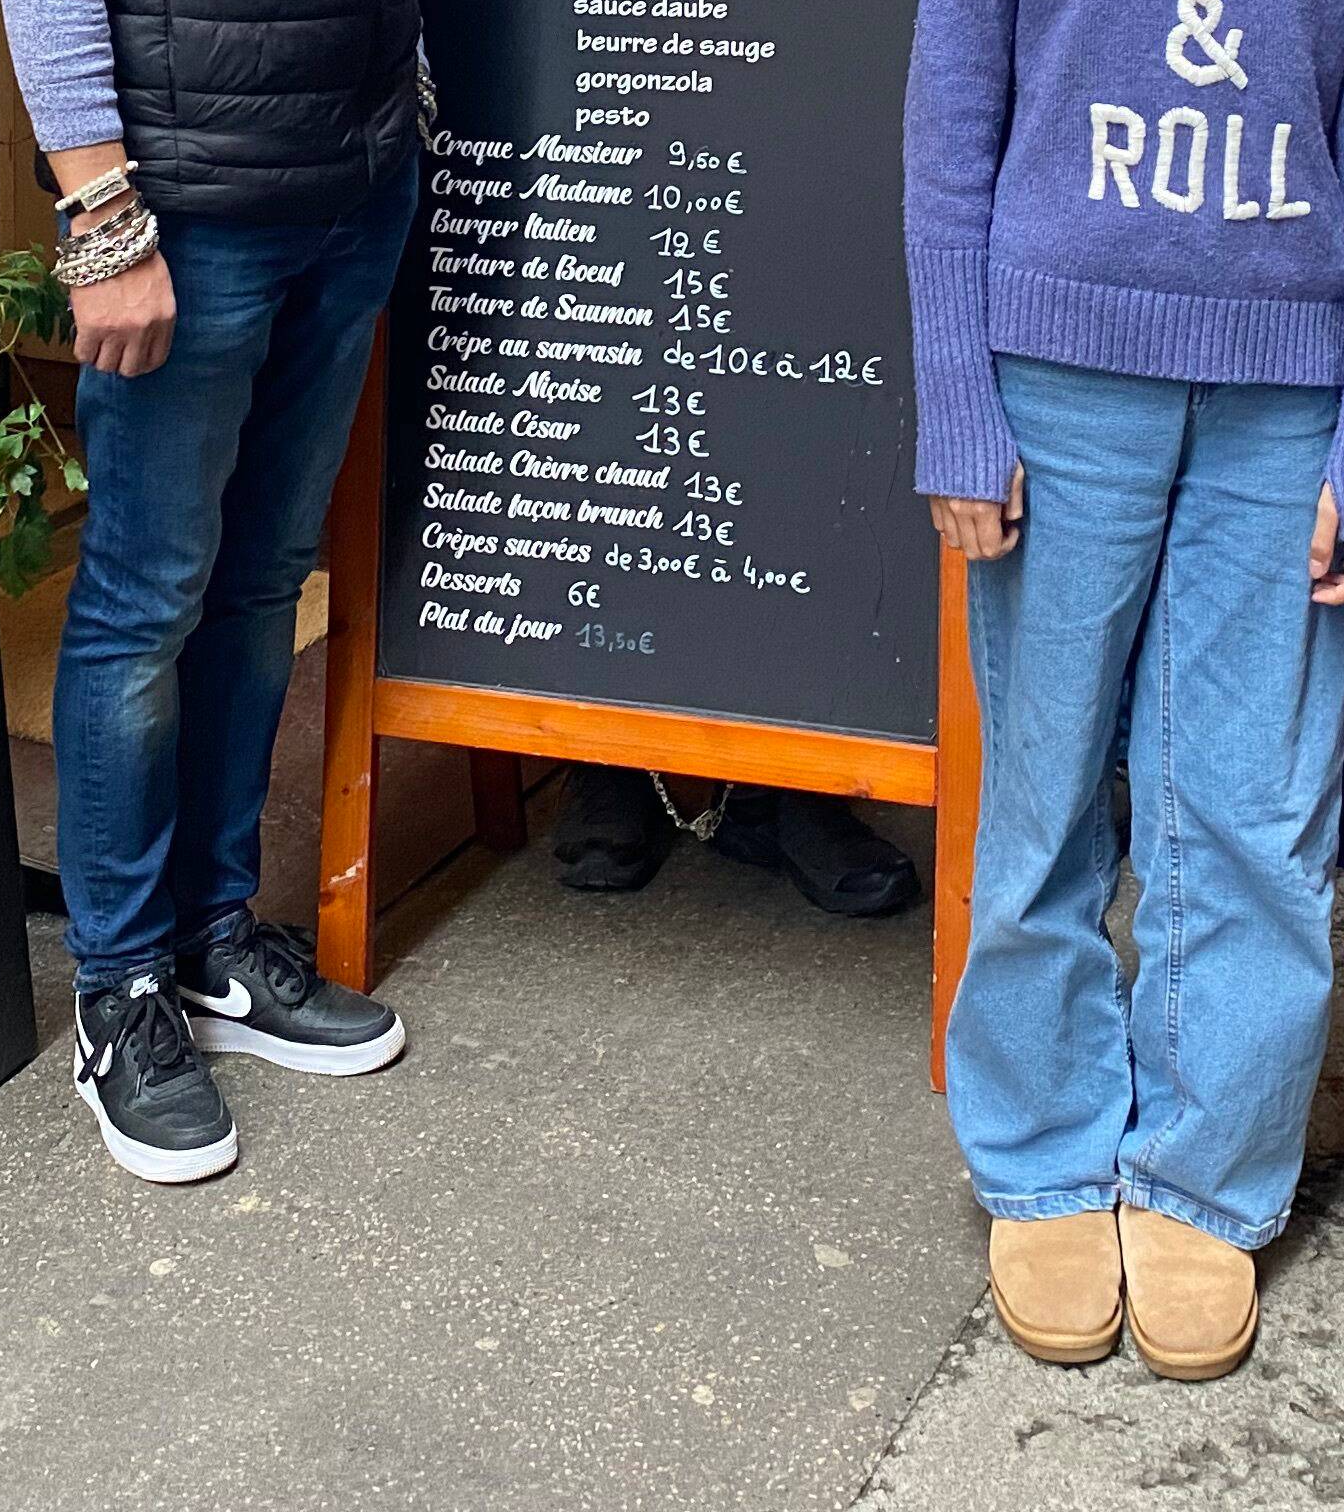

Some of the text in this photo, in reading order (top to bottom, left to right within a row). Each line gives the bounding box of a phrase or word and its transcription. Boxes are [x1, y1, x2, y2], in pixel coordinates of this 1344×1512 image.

[574, 0, 646, 16] sauce
[578, 29, 775, 63] beurre de sauge
[576, 70, 712, 94] gorgonzola
[576, 107, 649, 131] pesto
[433, 131, 513, 166] Croque
[520, 134, 642, 165] Monsieur
[1088, 102, 1312, 221] ROLL
[432, 170, 512, 205] Croque
[519, 174, 633, 205] Madame
[431, 209, 518, 244] Burger
[524, 213, 596, 242] Italien
[431, 247, 515, 277] Tartare
[522, 257, 549, 279] de
[555, 254, 625, 287] Boeuf
[430, 286, 514, 316] Tartare
[521, 296, 548, 319] de
[554, 294, 653, 326] Saumon
[428, 326, 492, 361] Crêpe
[499, 339, 530, 357] au
[536, 341, 643, 366] sarrasin
[664, 339, 696, 370] de
[427, 365, 506, 395] Salade
[512, 371, 602, 404] Niçoise
[426, 405, 505, 434] Salade
[511, 410, 580, 440] César
[425, 444, 503, 474] Salade
[510, 450, 589, 482] Chèvre
[595, 462, 670, 489] chaud
[424, 483, 502, 514] Salade
[508, 494, 571, 522] façon
[577, 500, 663, 529] brunch
[504, 537, 591, 562] sucrées
[605, 543, 632, 571] de
[421, 562, 521, 596] Desserts
[420, 601, 470, 631] Plat
[474, 611, 505, 635] du
[505, 614, 562, 644] jour
